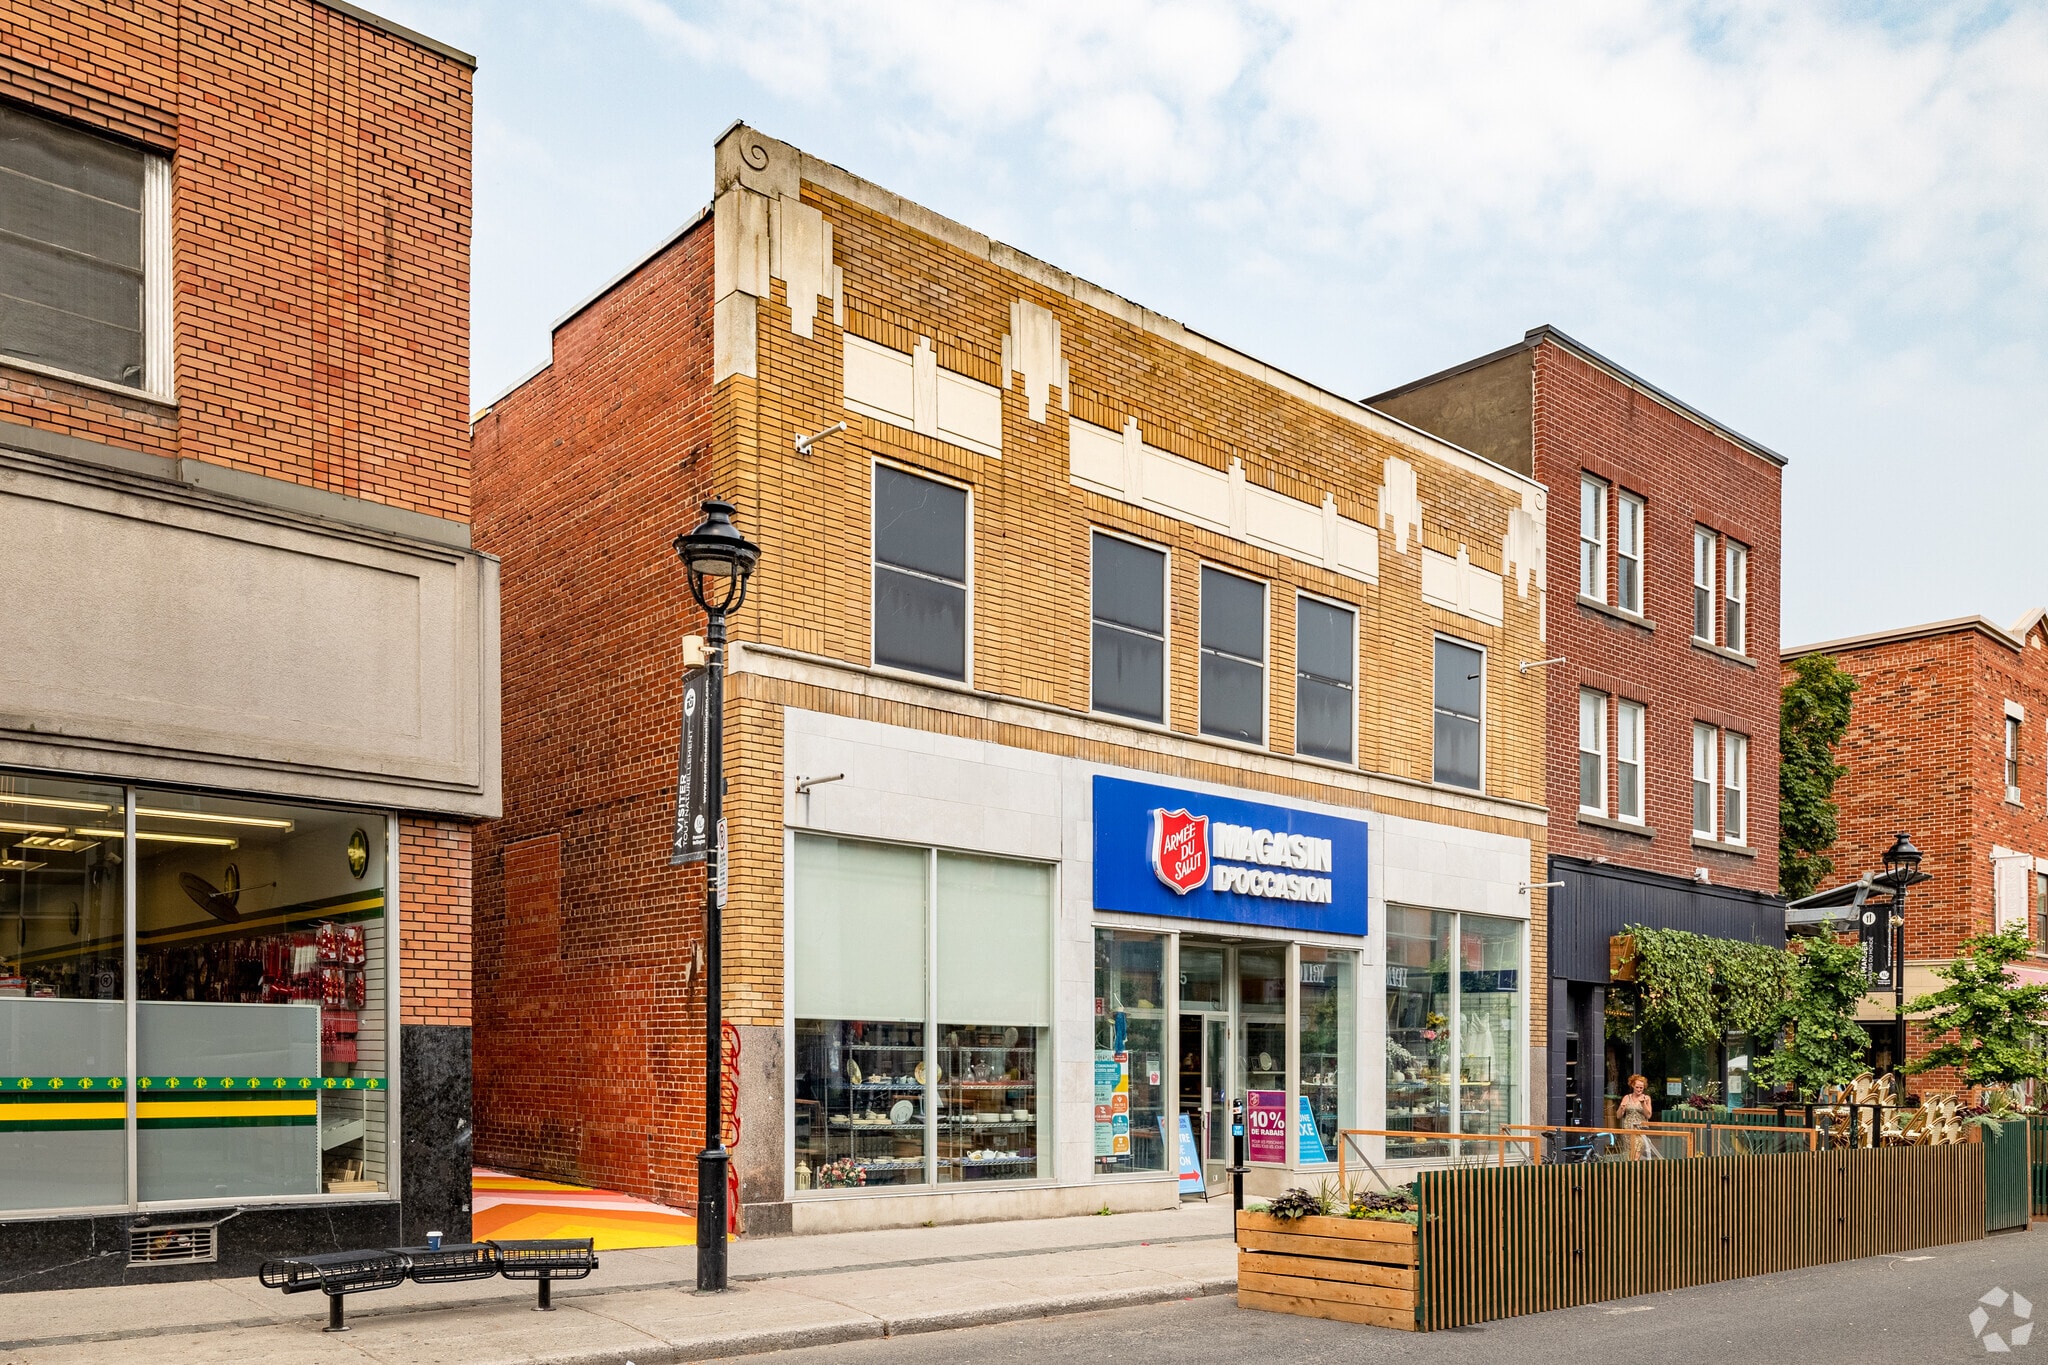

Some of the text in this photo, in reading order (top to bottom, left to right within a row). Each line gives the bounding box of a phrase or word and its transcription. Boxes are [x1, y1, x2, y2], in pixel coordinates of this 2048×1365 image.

[684, 731, 693, 817] NATURELLEMENT
[677, 774, 687, 833] VISITER
[1163, 822, 1196, 855] ARMÉE
[1181, 839, 1195, 861] DU
[1212, 822, 1332, 873] MAGASIN
[1175, 851, 1202, 880] SALUT
[1212, 864, 1332, 904] D'OCCASION
[1868, 955, 1873, 963] DU
[1250, 1111, 1285, 1129] 10%
